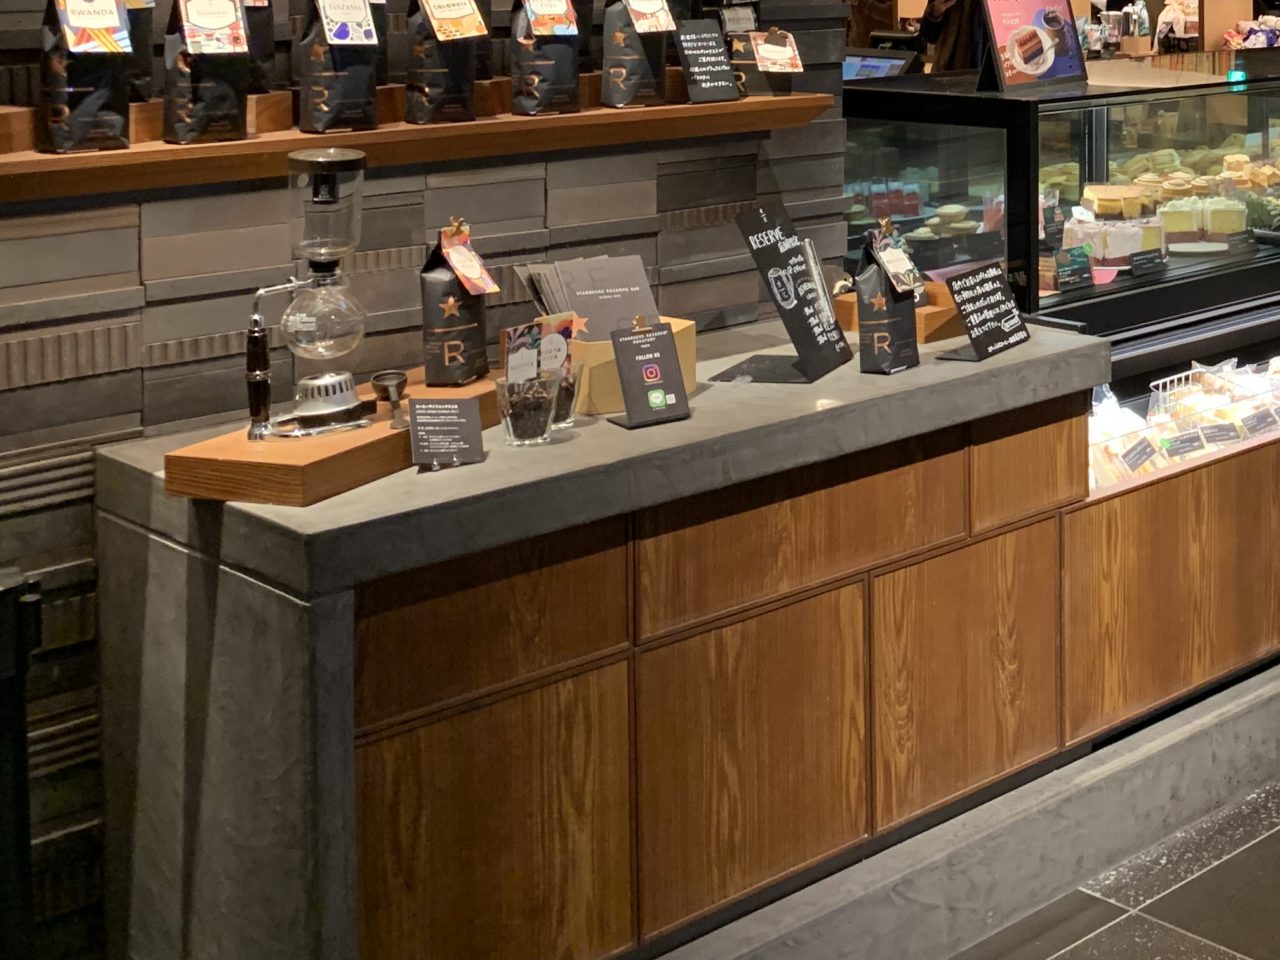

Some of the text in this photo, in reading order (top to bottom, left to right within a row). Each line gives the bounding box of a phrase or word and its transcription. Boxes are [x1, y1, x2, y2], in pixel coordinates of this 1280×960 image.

[70, 8, 115, 16] RWANDA
[609, 67, 627, 91] R
[748, 226, 786, 250] RESERVE
[444, 340, 466, 366] R
[873, 332, 892, 356] R
[635, 353, 653, 361] FOLLOW
